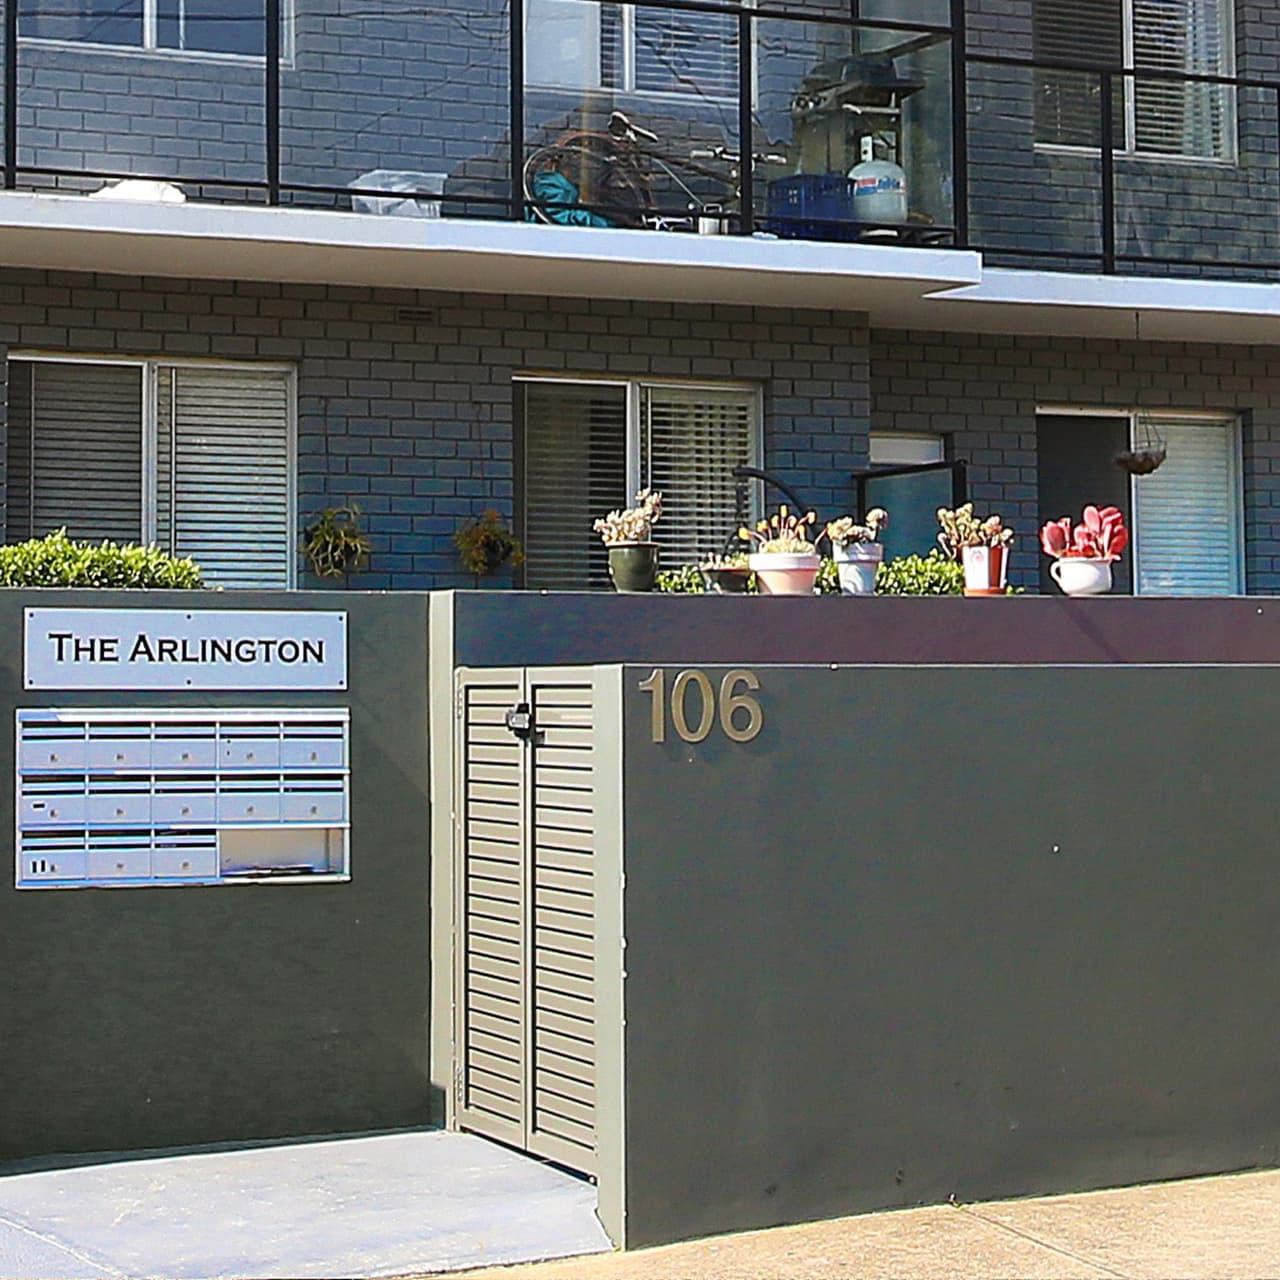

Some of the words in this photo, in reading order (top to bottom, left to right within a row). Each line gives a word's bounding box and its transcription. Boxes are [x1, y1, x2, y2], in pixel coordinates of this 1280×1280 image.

[48, 632, 120, 662] THE
[129, 633, 325, 663] ARLINGTON
[638, 668, 764, 744] 106
